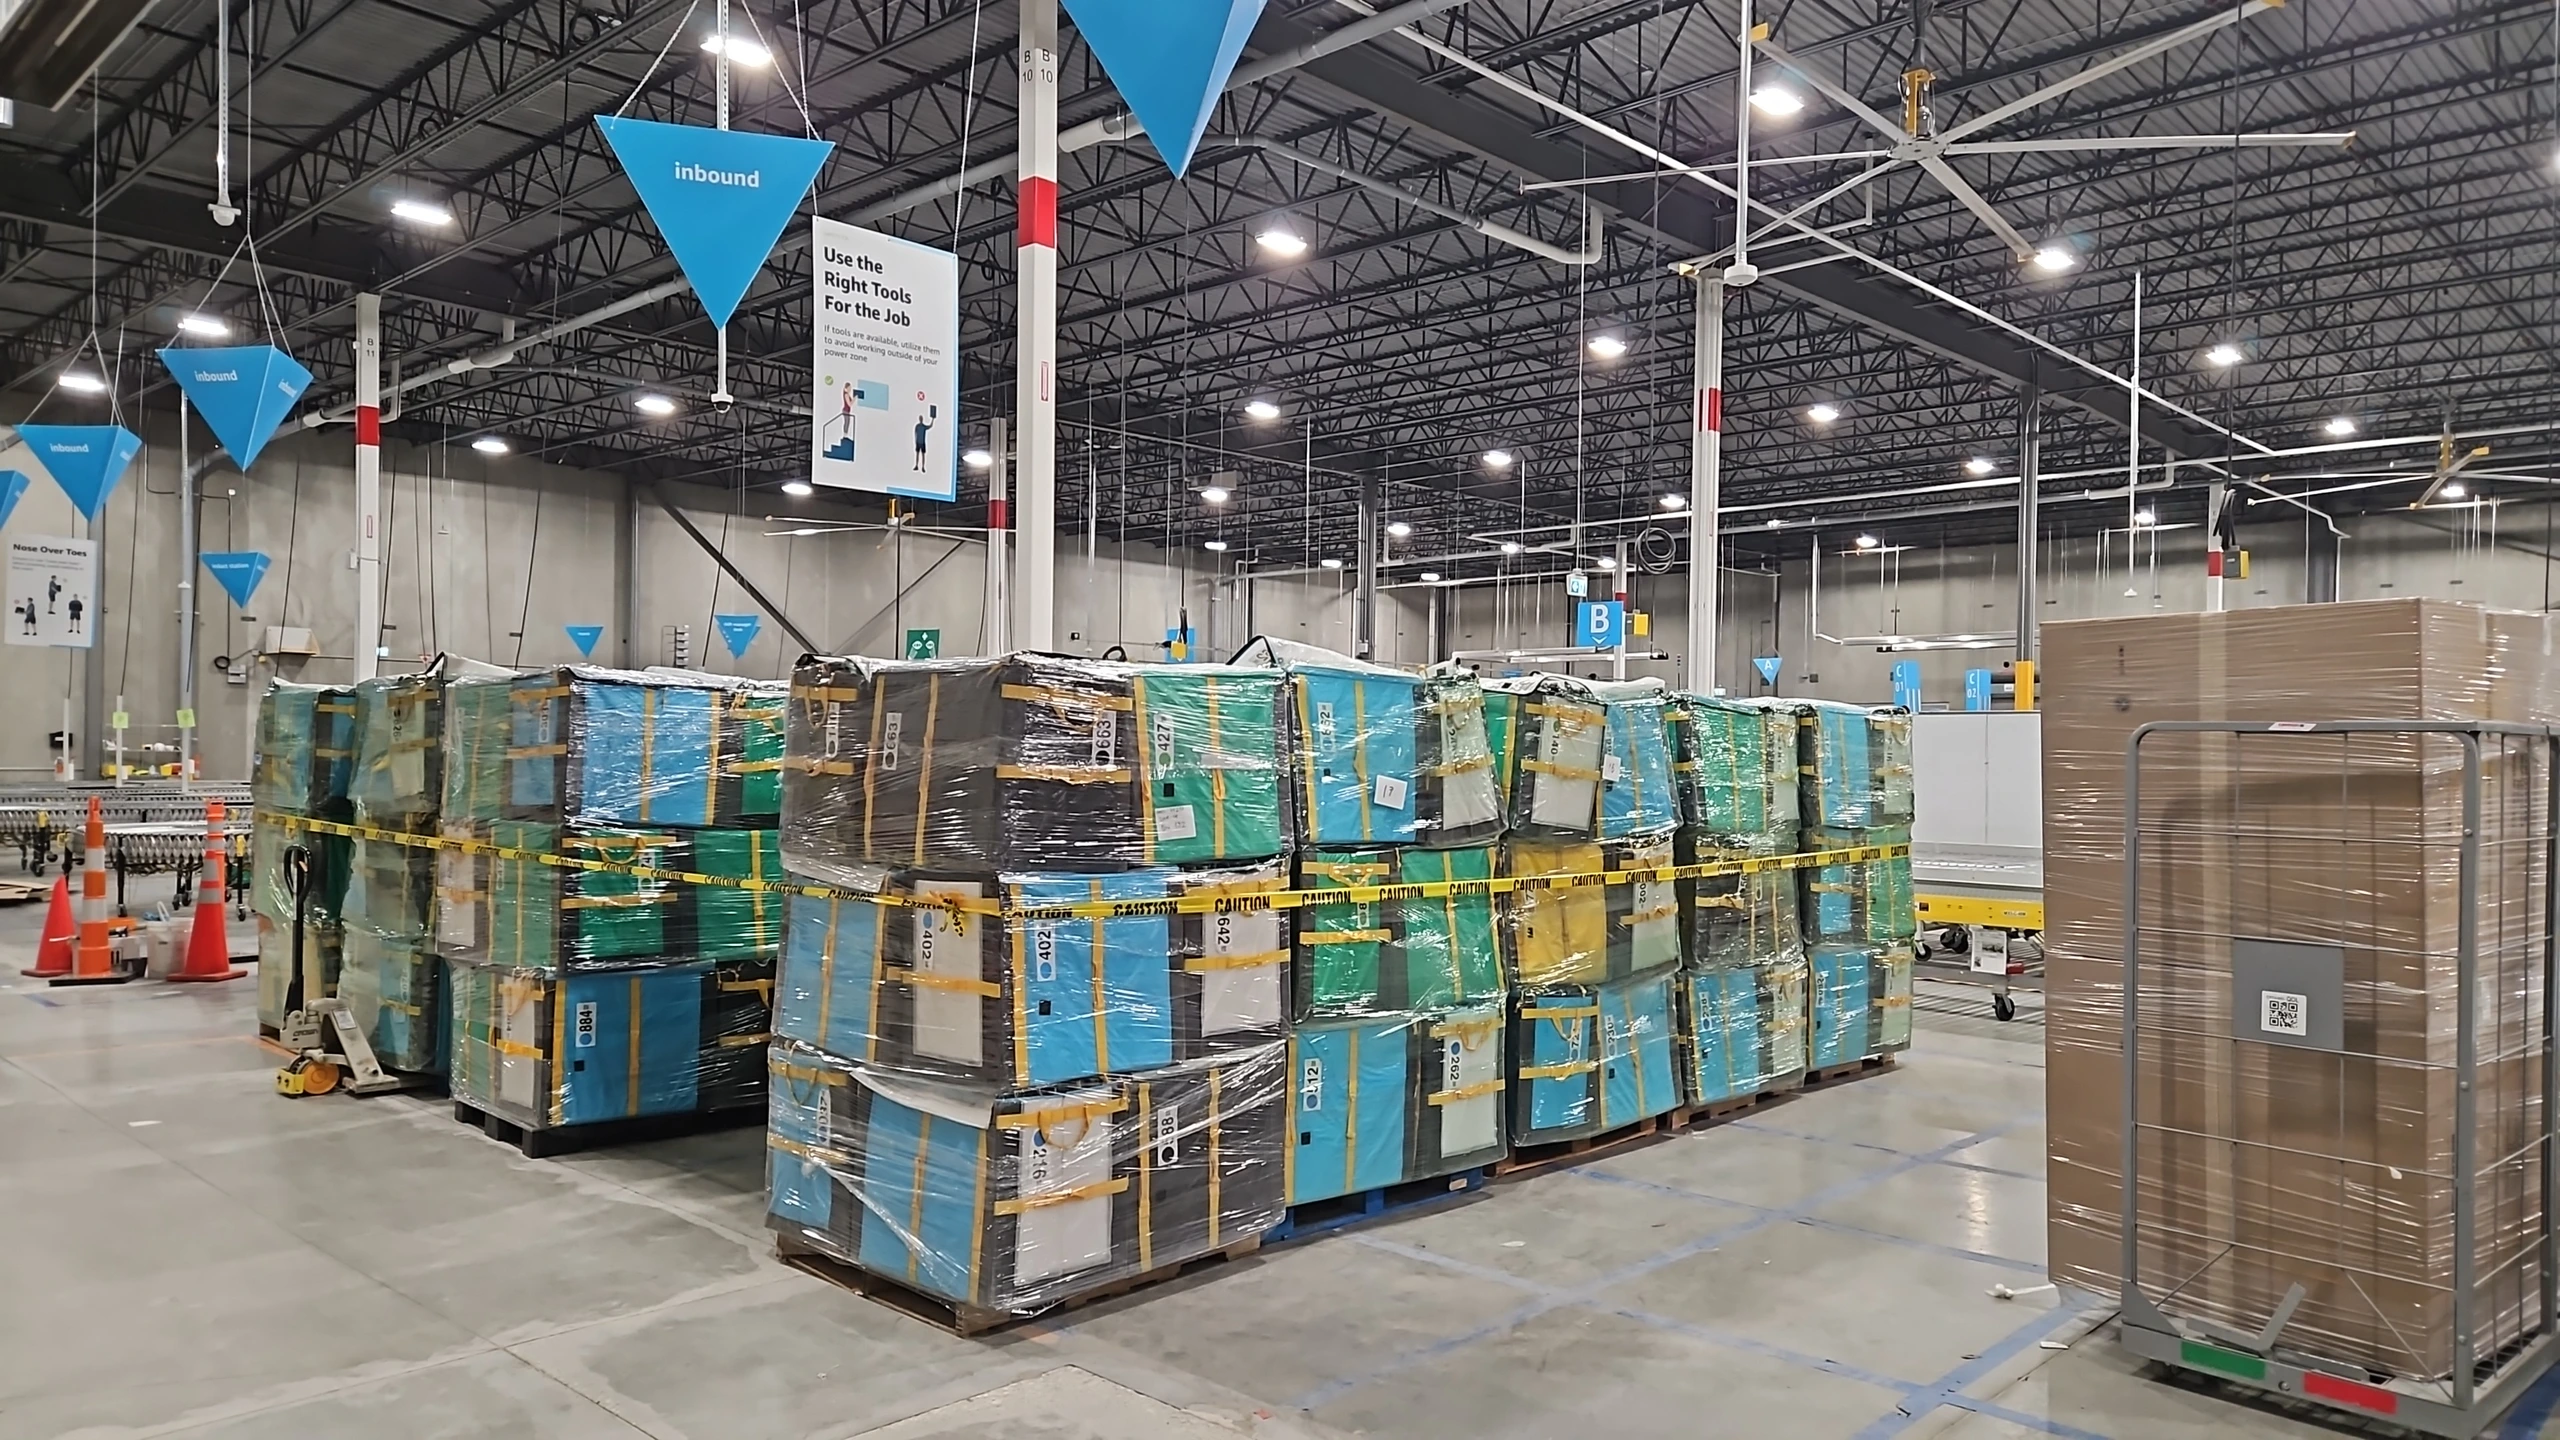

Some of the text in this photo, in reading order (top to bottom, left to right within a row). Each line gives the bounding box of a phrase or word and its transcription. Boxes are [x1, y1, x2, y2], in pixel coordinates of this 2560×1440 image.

[1025, 50, 1031, 63] B
[1042, 48, 1050, 62] B
[1022, 69, 1033, 83] 10
[1041, 69, 1053, 83] 10
[675, 162, 760, 188] inbound
[824, 246, 883, 275] Use the
[824, 270, 912, 304] Right Tools
[825, 295, 910, 327] For the Job
[367, 337, 374, 346] B
[824, 324, 941, 356] If tools are available, utilize them
[366, 349, 375, 358] 11
[824, 336, 938, 366] to avoid working outside of your
[824, 348, 868, 363] power zone
[194, 370, 238, 383] inbound
[50, 443, 90, 453] inbound
[13, 544, 88, 557] Nose Over Toes
[1590, 604, 1610, 634] B
[1764, 660, 1773, 671] A
[1896, 665, 1902, 677] C
[1895, 681, 1904, 692] 01
[1969, 673, 1976, 685] C
[1967, 688, 1977, 698] 02
[884, 722, 898, 750] 663
[1095, 720, 1112, 749] 663
[1157, 724, 1171, 751] 427
[1551, 734, 1560, 755] 140
[1113, 901, 1178, 916] CAUTION
[1214, 896, 1271, 913] CAUTION
[1302, 890, 1351, 906] CAUTION
[1379, 886, 1424, 900] CAUTION
[1450, 882, 1491, 897] CAUTION
[1513, 878, 1551, 892] CAUTION
[1572, 873, 1607, 887] CAUTION
[1626, 869, 1658, 884] CAUTION
[1674, 866, 1703, 879] CAUTION
[1758, 859, 1782, 872] CAUTION
[1795, 856, 1818, 868] CAUTION
[1829, 852, 1850, 865] CAUTION
[1861, 848, 1881, 861] CAUTION
[1891, 845, 1909, 858] CAUTION
[763, 882, 805, 894] CAUTION
[828, 889, 874, 903] CAUTION
[1217, 917, 1230, 945] 642
[922, 930, 933, 960] 402
[1037, 931, 1052, 960] 402
[579, 1010, 593, 1032] 884
[1450, 1056, 1460, 1081] 262
[1032, 1148, 1047, 1179] 216
